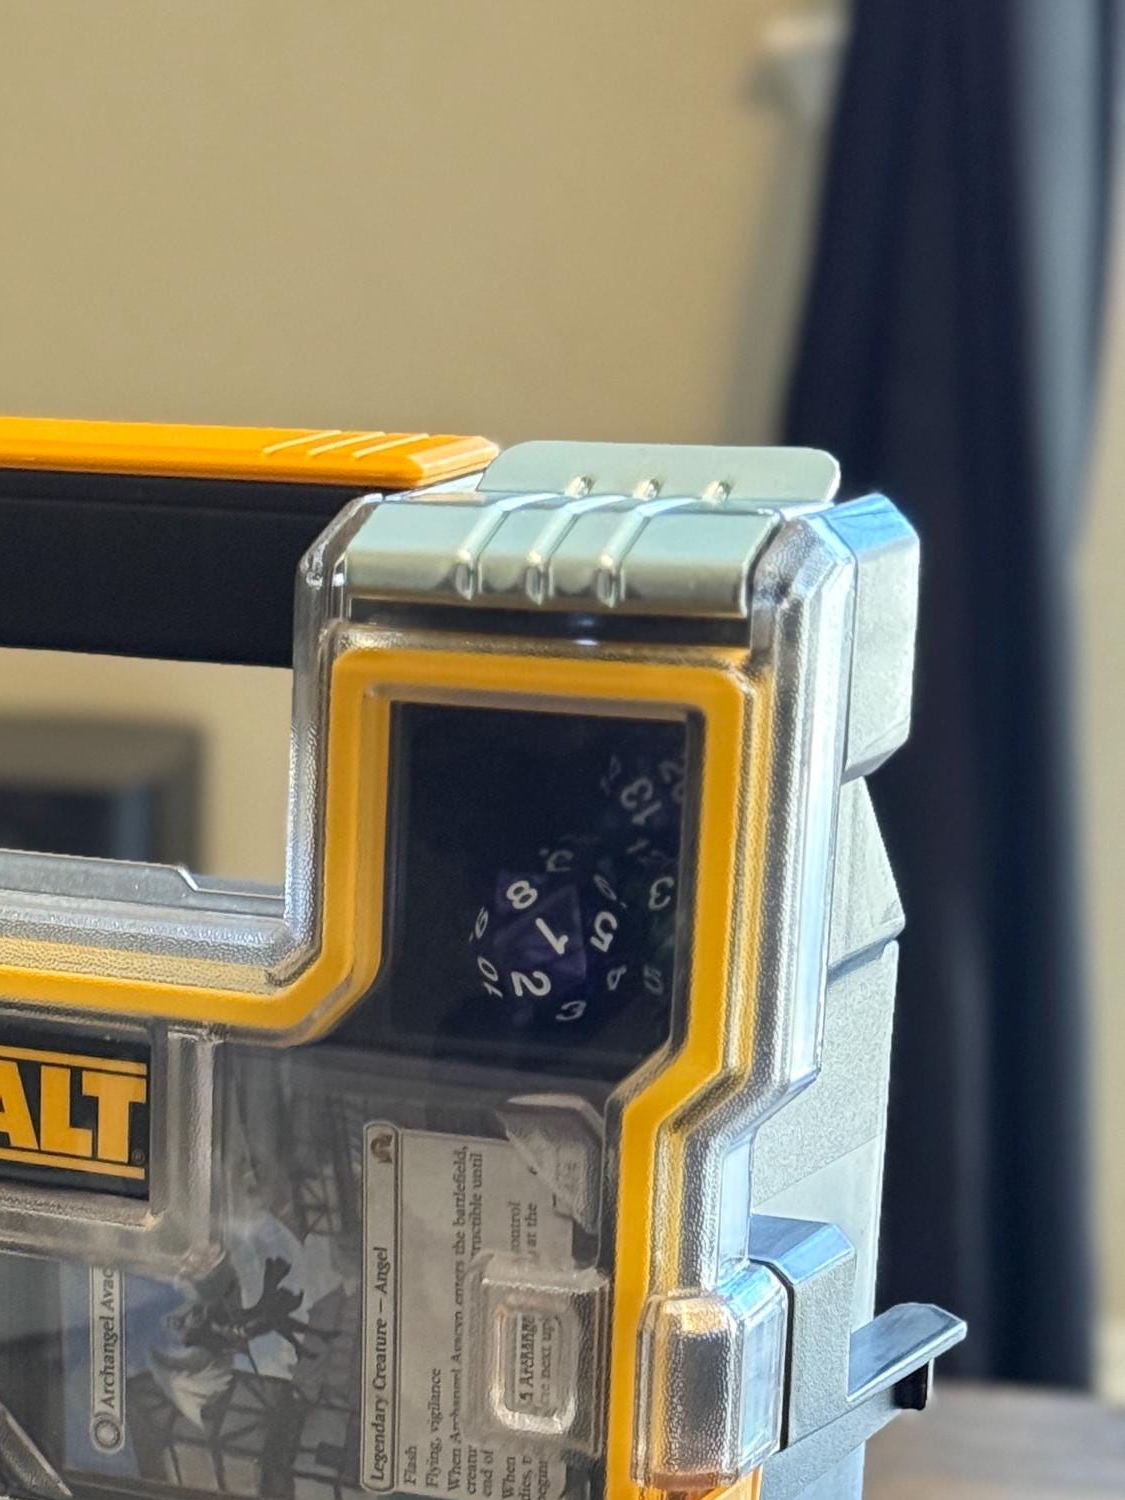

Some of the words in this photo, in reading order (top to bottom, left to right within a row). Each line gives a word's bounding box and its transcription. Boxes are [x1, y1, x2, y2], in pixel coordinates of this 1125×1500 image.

[506, 880, 538, 910] 8
[535, 917, 569, 954] 1
[590, 911, 618, 952] 5
[510, 970, 552, 996] 2
[470, 1153, 482, 1189] until
[453, 1232, 466, 1254] the
[99, 1269, 114, 1312] Avac
[373, 1247, 388, 1294] Angel
[99, 1316, 117, 1409] Archangel
[372, 1318, 387, 1390] Creature
[427, 1369, 442, 1433] vigilance
[371, 1398, 389, 1482] Legendary
[482, 1449, 493, 1464] of
[404, 1446, 417, 1485] Flash
[448, 1448, 462, 1491] When
[481, 1468, 493, 1497] end
[502, 1456, 516, 1499] When
